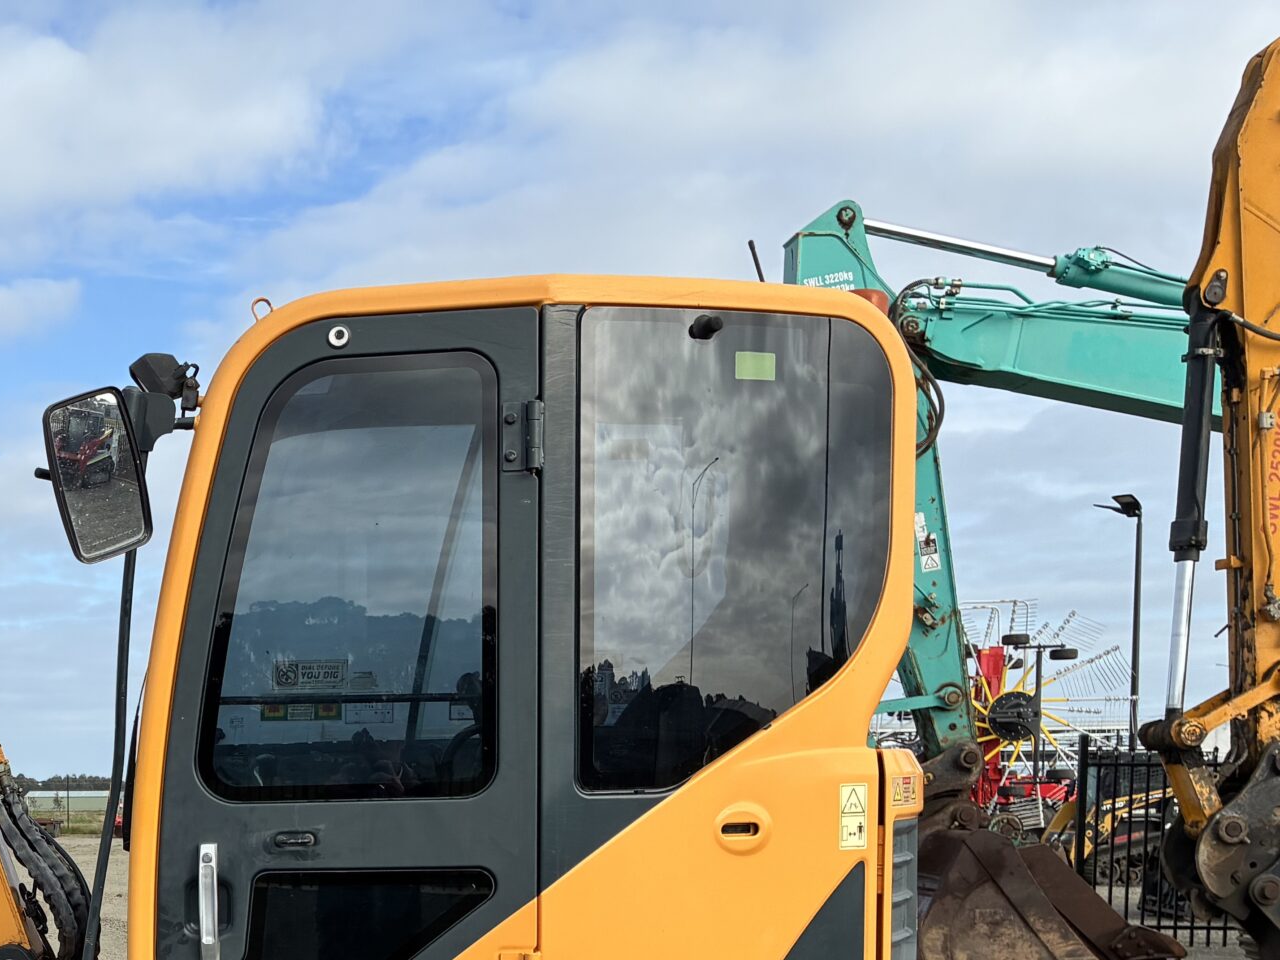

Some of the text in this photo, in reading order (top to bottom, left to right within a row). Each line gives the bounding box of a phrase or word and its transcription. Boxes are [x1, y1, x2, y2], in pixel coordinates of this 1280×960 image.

[824, 271, 853, 285] 3220kg
[301, 671, 340, 680] YOU DIG
